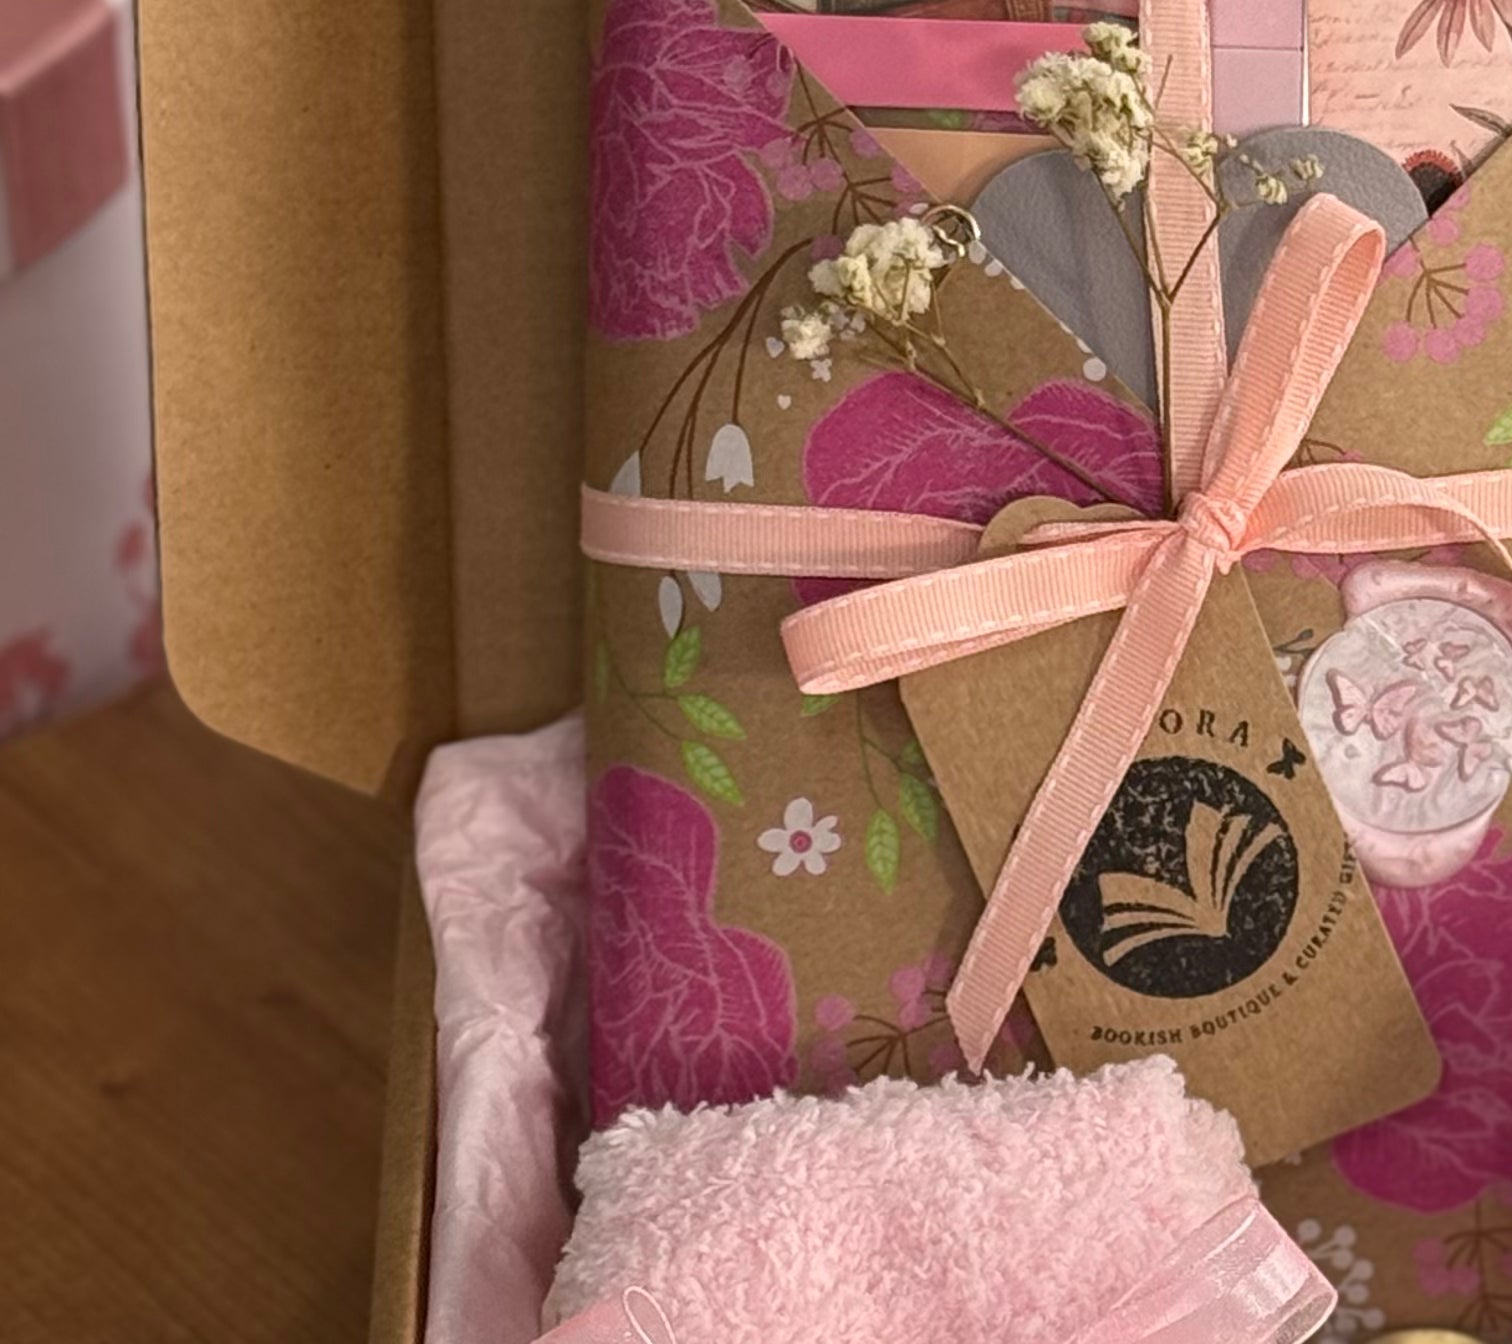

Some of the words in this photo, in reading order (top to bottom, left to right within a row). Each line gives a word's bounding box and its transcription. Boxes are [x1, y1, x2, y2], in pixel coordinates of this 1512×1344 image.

[1158, 708, 1249, 748] ORA
[1090, 1026, 1183, 1047] BOOKISH
[1189, 984, 1282, 1039] BOUTIQUE
[1282, 972, 1299, 986] &
[1296, 890, 1347, 969] CURATED
